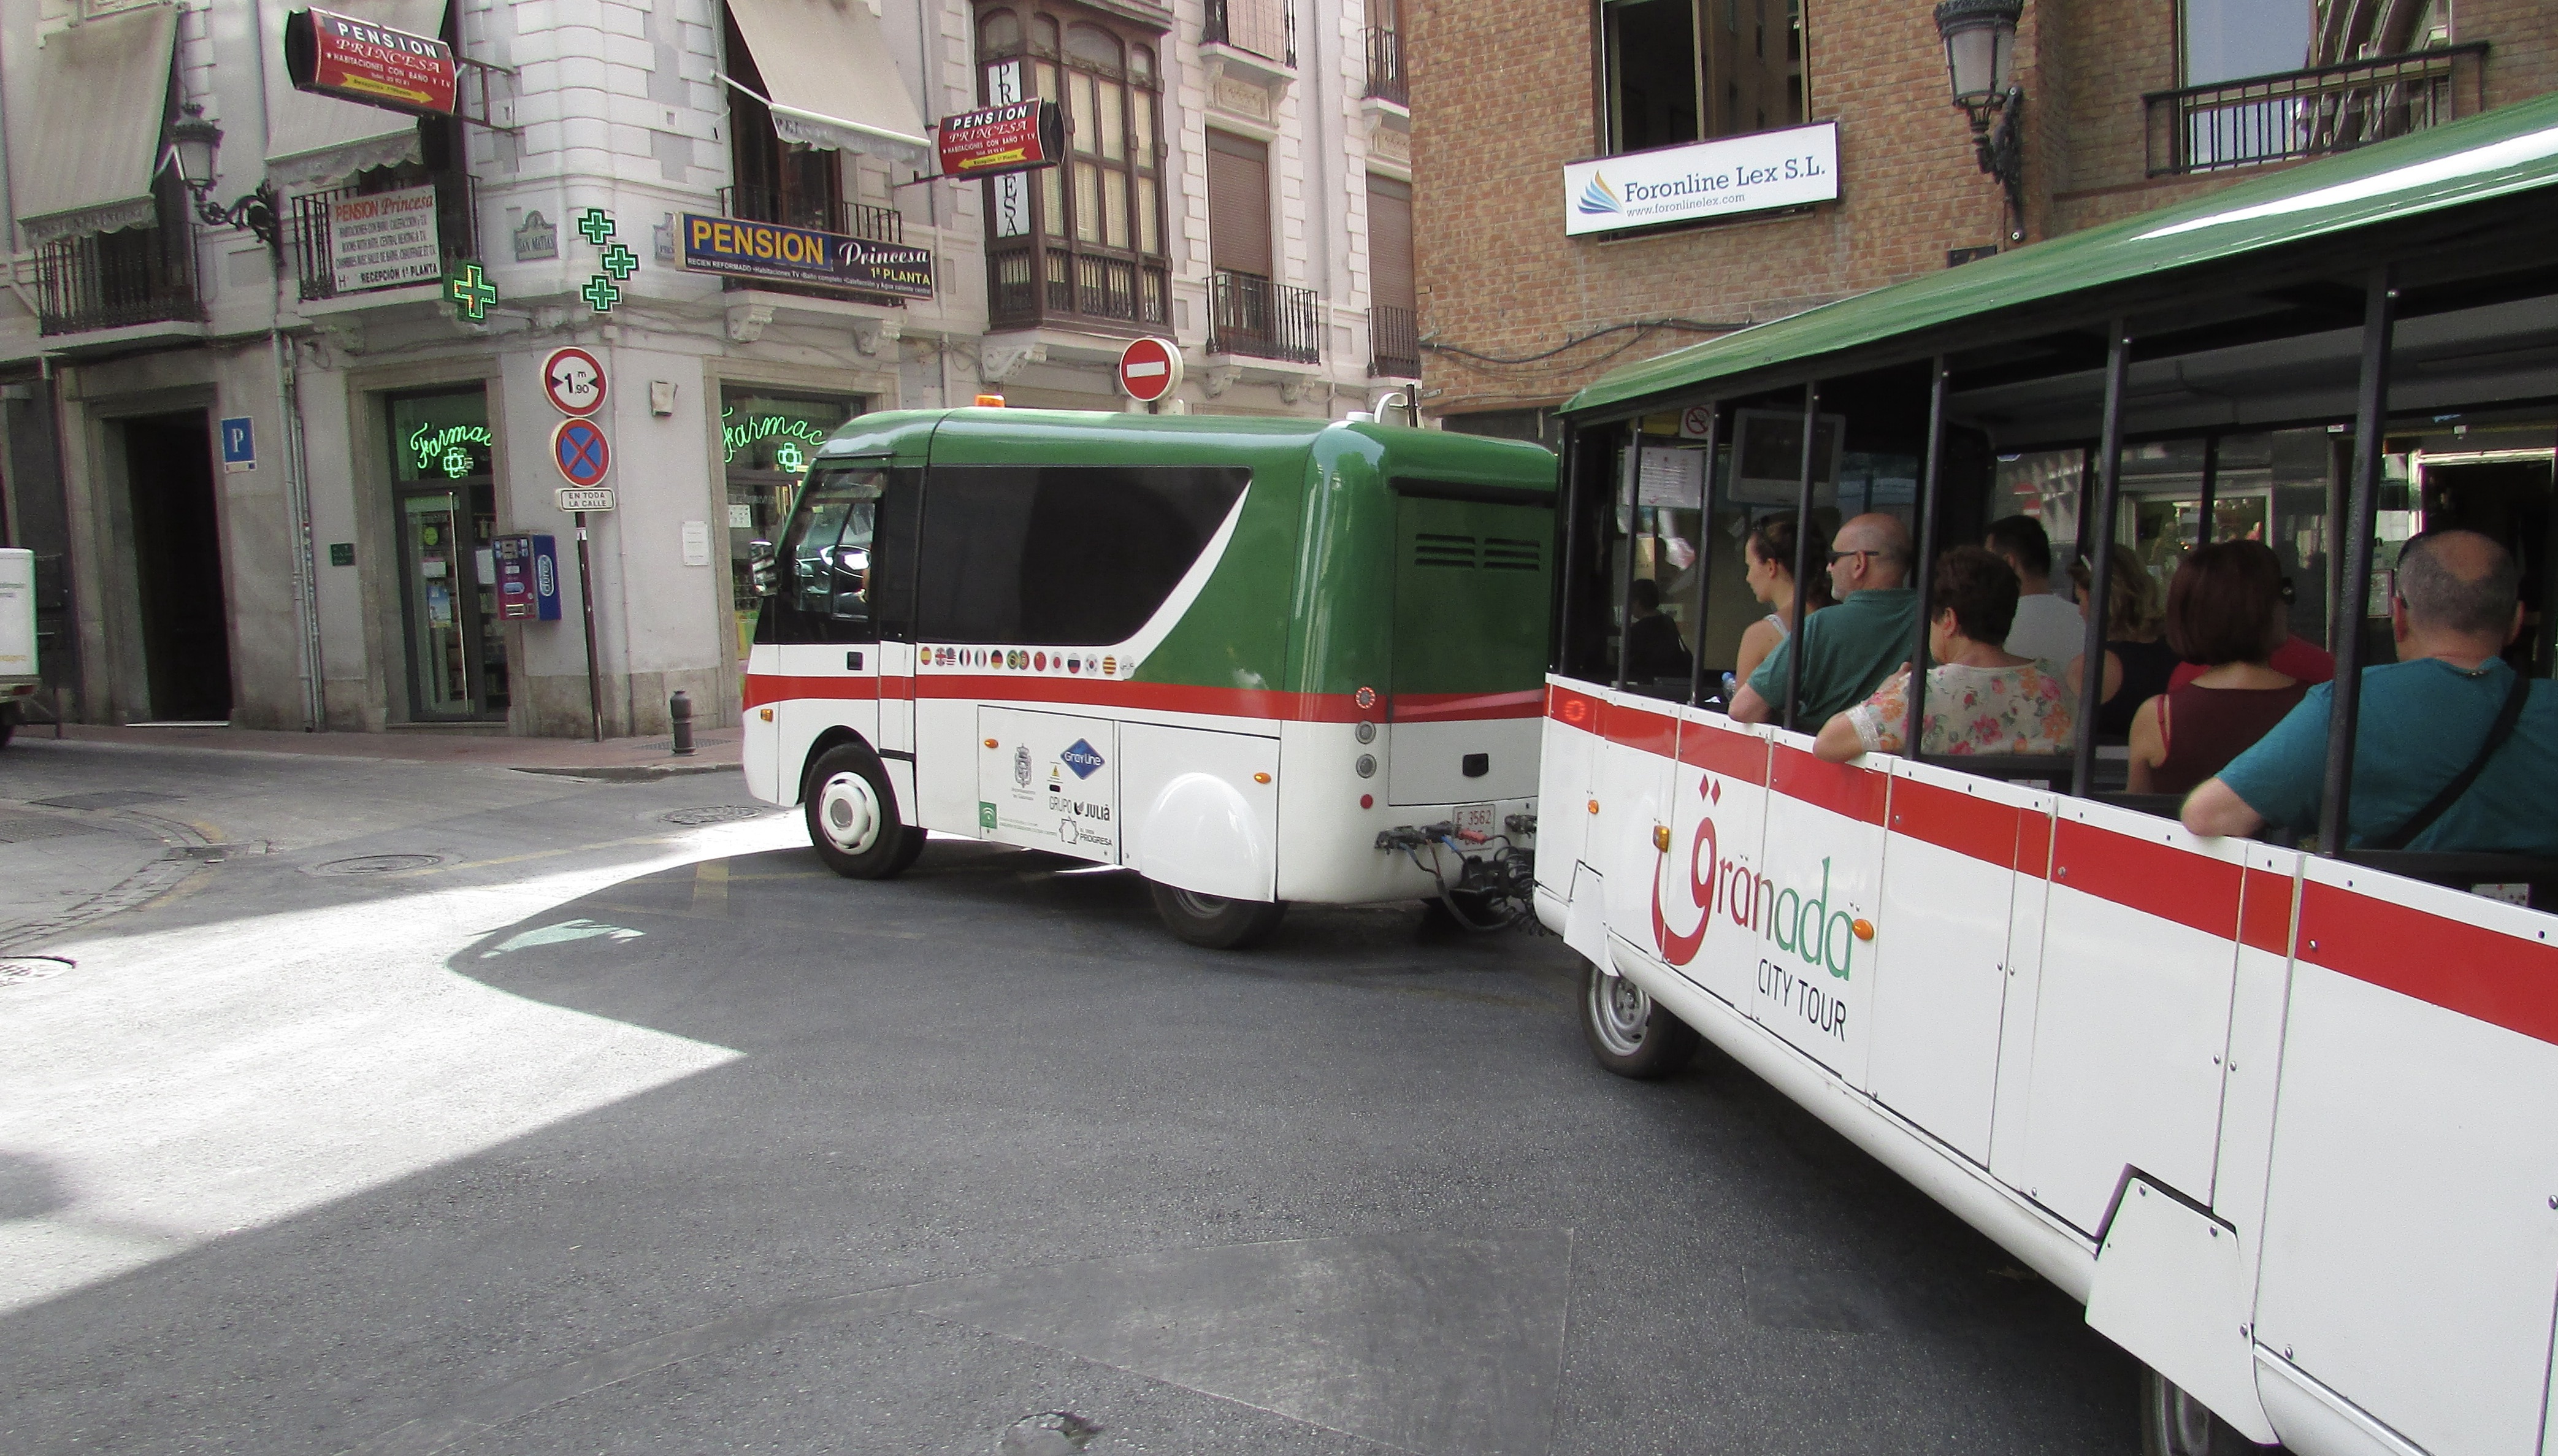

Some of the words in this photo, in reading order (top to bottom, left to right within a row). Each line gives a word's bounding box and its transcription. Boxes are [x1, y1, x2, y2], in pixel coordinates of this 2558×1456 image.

[337, 22, 438, 59] PENSION
[337, 39, 442, 74] PRINCESA
[388, 67, 405, 77] CON
[953, 105, 1028, 131] PENSION
[949, 120, 1027, 143] PRINCESA
[986, 139, 999, 147] CON
[1624, 172, 1730, 204] Foronline
[1736, 164, 1779, 186] Lex
[1784, 155, 1826, 181] S.L.
[335, 199, 379, 223] PENSION
[382, 195, 433, 215] Princesa
[1626, 192, 1746, 218] www.foronlinelex.com
[692, 218, 824, 266] PENSION
[687, 258, 711, 267] RECIEN
[712, 260, 752, 272] REFORMADO
[838, 242, 930, 267] Princesa
[360, 266, 400, 283] RECEPCIÓN
[410, 262, 439, 277] PLANTA
[883, 267, 931, 286] PLANTA
[1049, 795, 1072, 814] GRUPO
[1468, 810, 1492, 826] 3562
[1079, 832, 1113, 846] PROGRESA
[1758, 958, 1794, 1008] CITY
[1798, 978, 1845, 1043] TOUR
